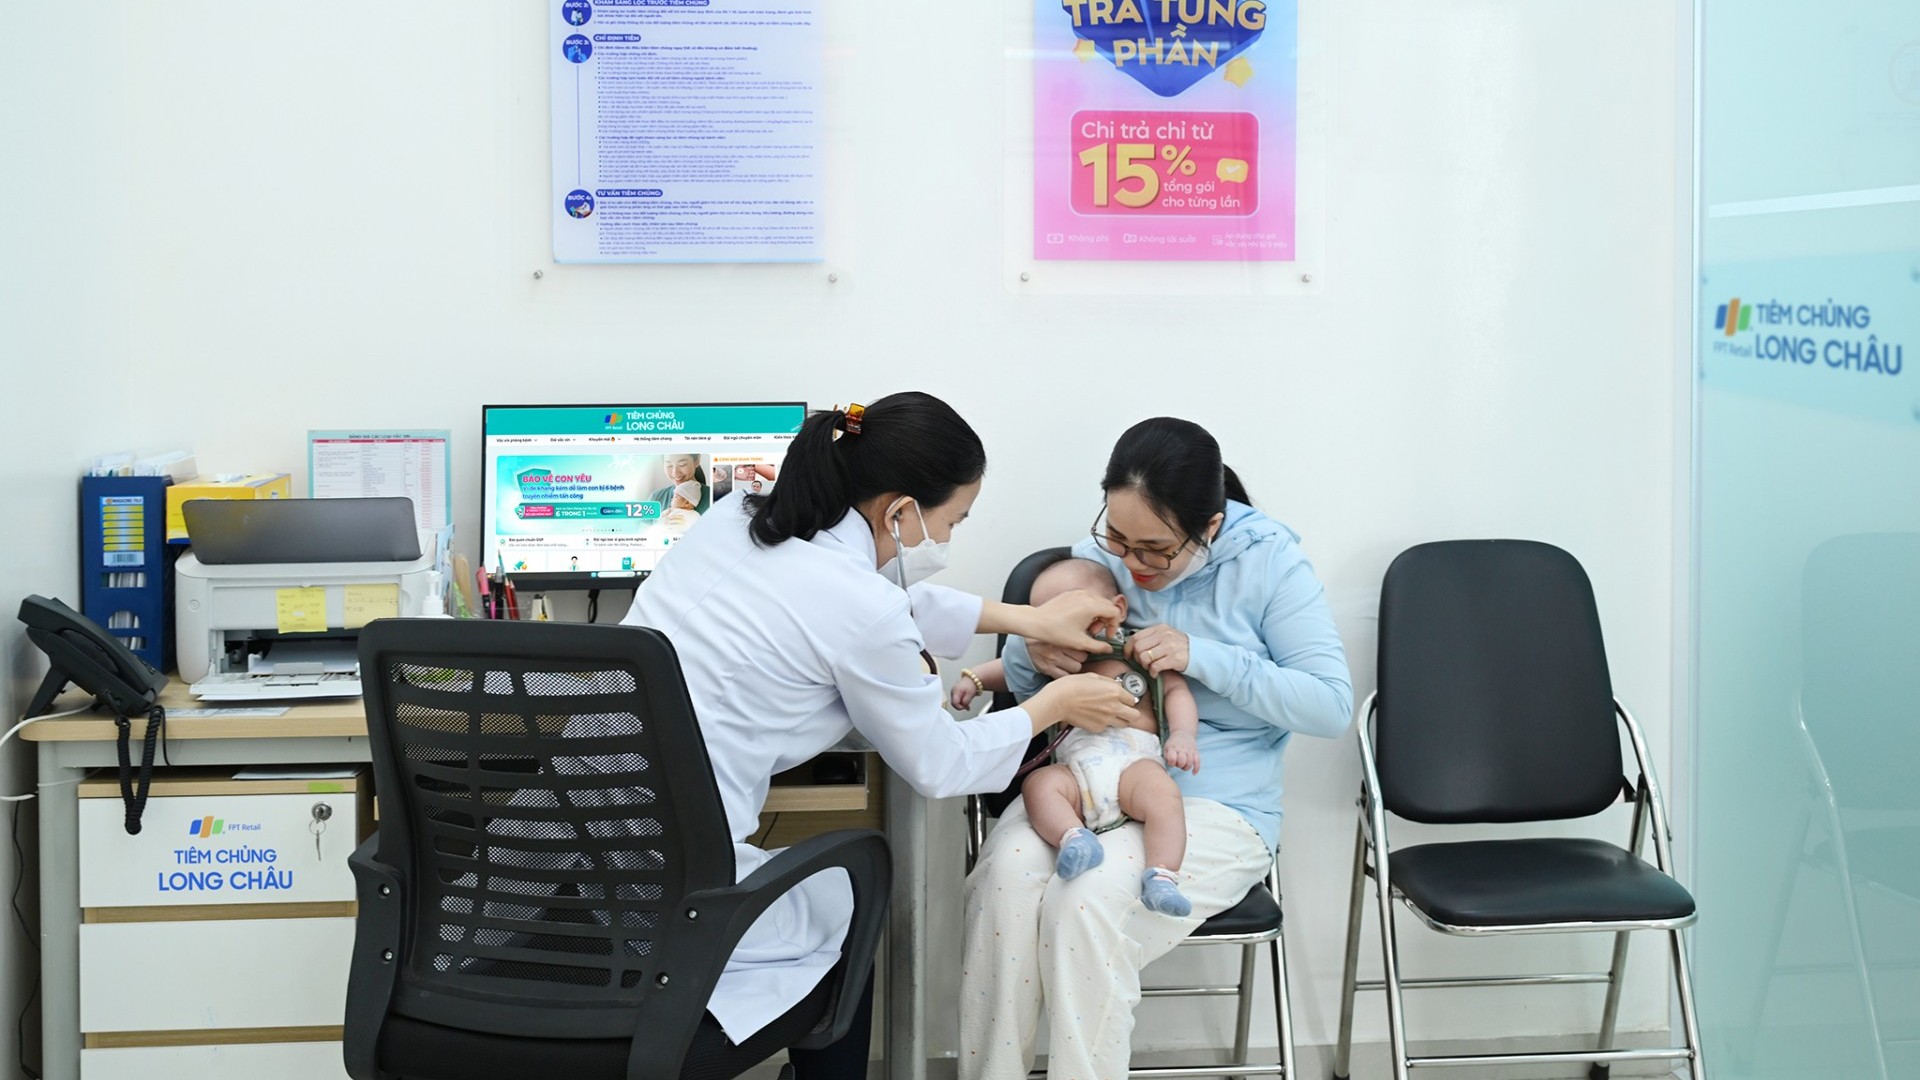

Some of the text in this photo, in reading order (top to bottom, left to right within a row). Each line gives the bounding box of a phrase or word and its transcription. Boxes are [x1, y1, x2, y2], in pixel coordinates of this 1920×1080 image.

[1113, 23, 1219, 69] PHẦN
[1081, 120, 1214, 140] Chi trả chỉ từ
[1078, 142, 1198, 208] 15%
[1164, 178, 1215, 194] tổng gói
[1162, 194, 1240, 209] cho từng lần
[1756, 297, 1871, 329] TIÊM CHỦNG
[1756, 333, 1902, 376] LONG CHÂU
[626, 410, 675, 420] TIÊM CHỦNG
[626, 418, 685, 431] LONG CHÂU
[554, 475, 574, 483] CON
[574, 473, 592, 483] YÊU
[625, 503, 655, 517] 12%
[241, 823, 261, 831] Retail
[174, 844, 277, 864] TIÊM CHỦNG
[158, 865, 293, 891] LONG CHÂU
